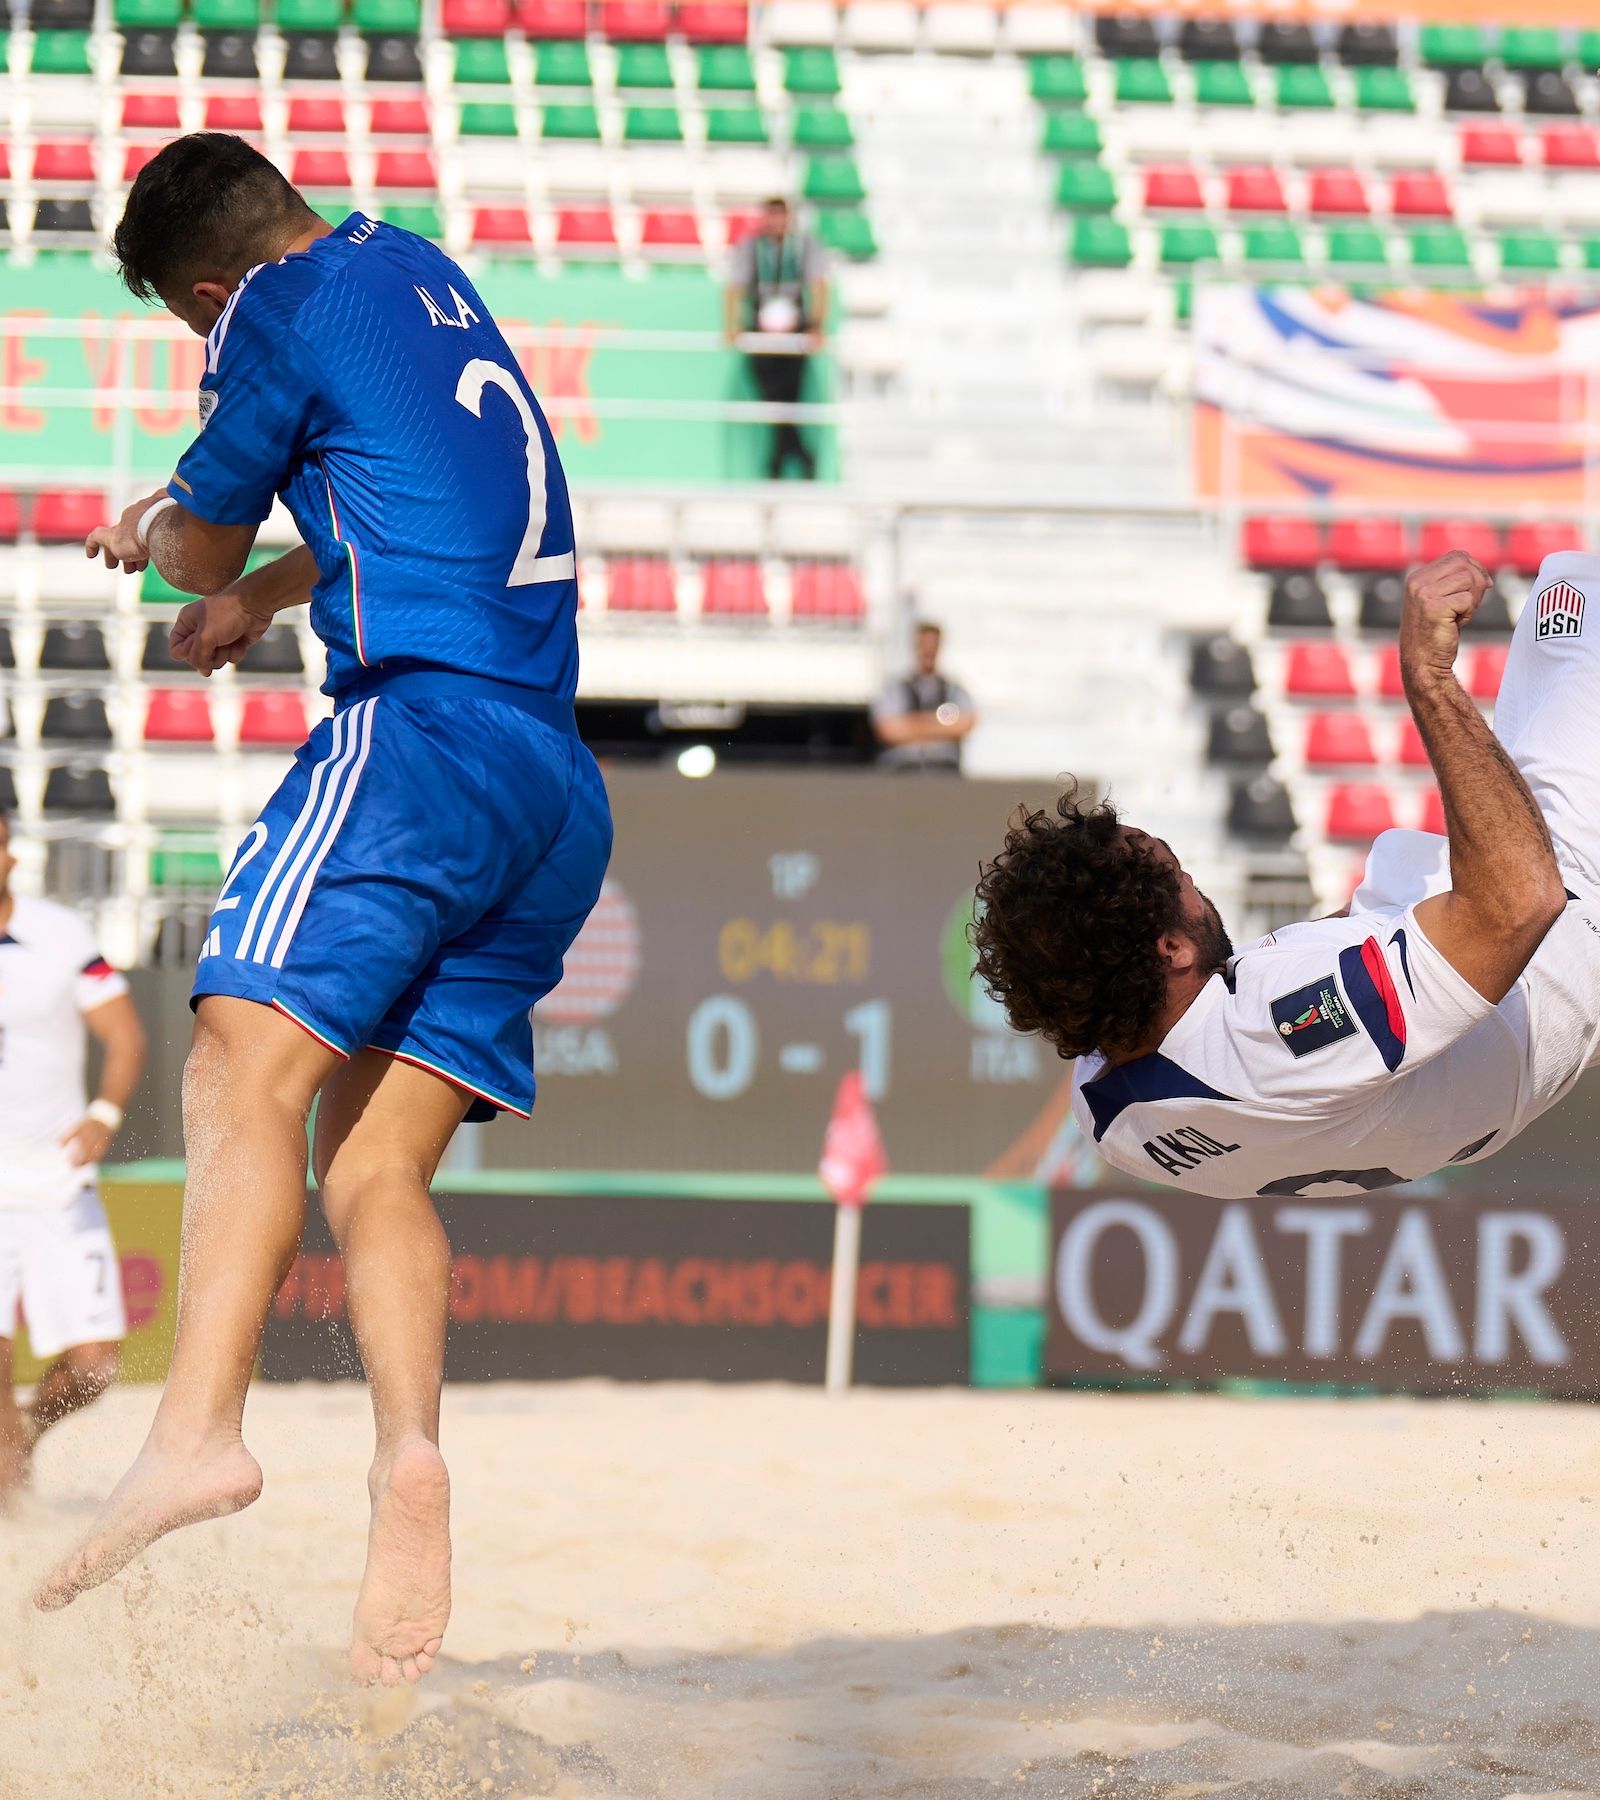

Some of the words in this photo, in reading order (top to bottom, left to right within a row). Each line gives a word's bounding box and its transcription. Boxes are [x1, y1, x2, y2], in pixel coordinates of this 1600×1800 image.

[455, 357, 576, 588] 2
[1539, 612, 1578, 637] USA
[211, 821, 269, 916] 2
[718, 918, 873, 984] 04:21
[1322, 988, 1335, 1010] 2024
[1331, 1010, 1344, 1027] UAE
[1055, 1200, 1571, 1371] QATAR
